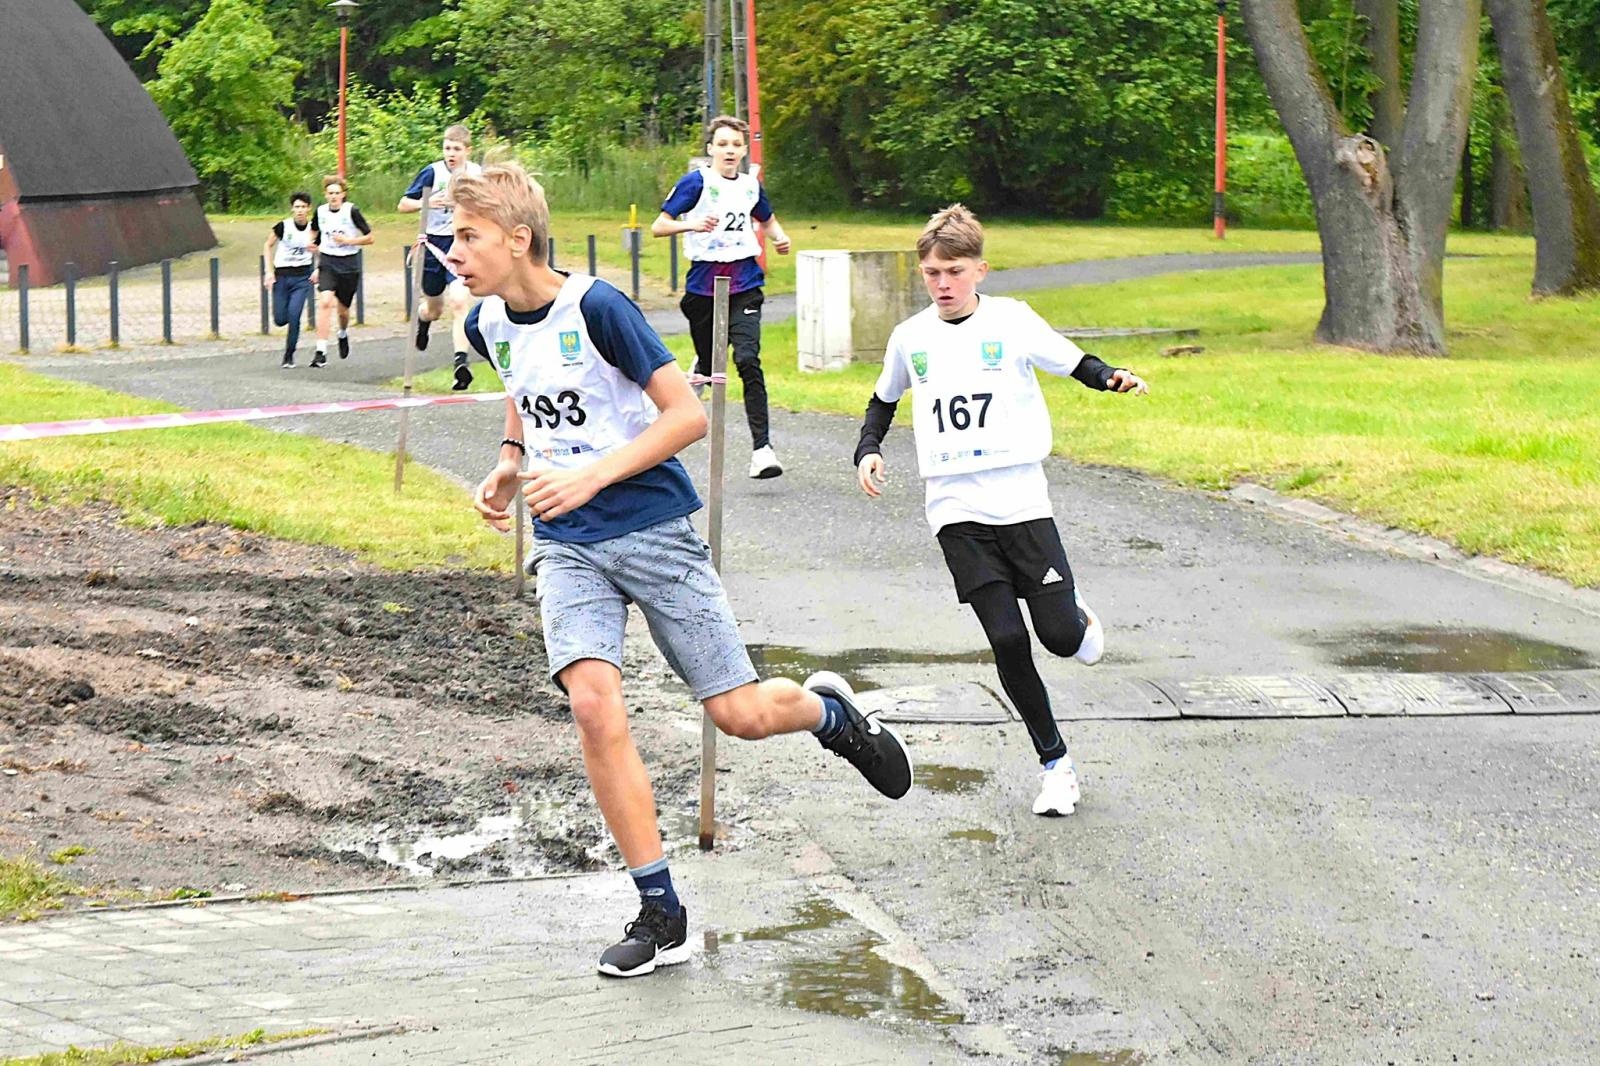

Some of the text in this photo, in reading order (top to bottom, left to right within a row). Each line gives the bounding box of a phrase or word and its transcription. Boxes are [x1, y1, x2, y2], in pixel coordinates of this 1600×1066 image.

[724, 211, 746, 231] 22
[521, 390, 587, 430] 193
[932, 392, 993, 433] 167
